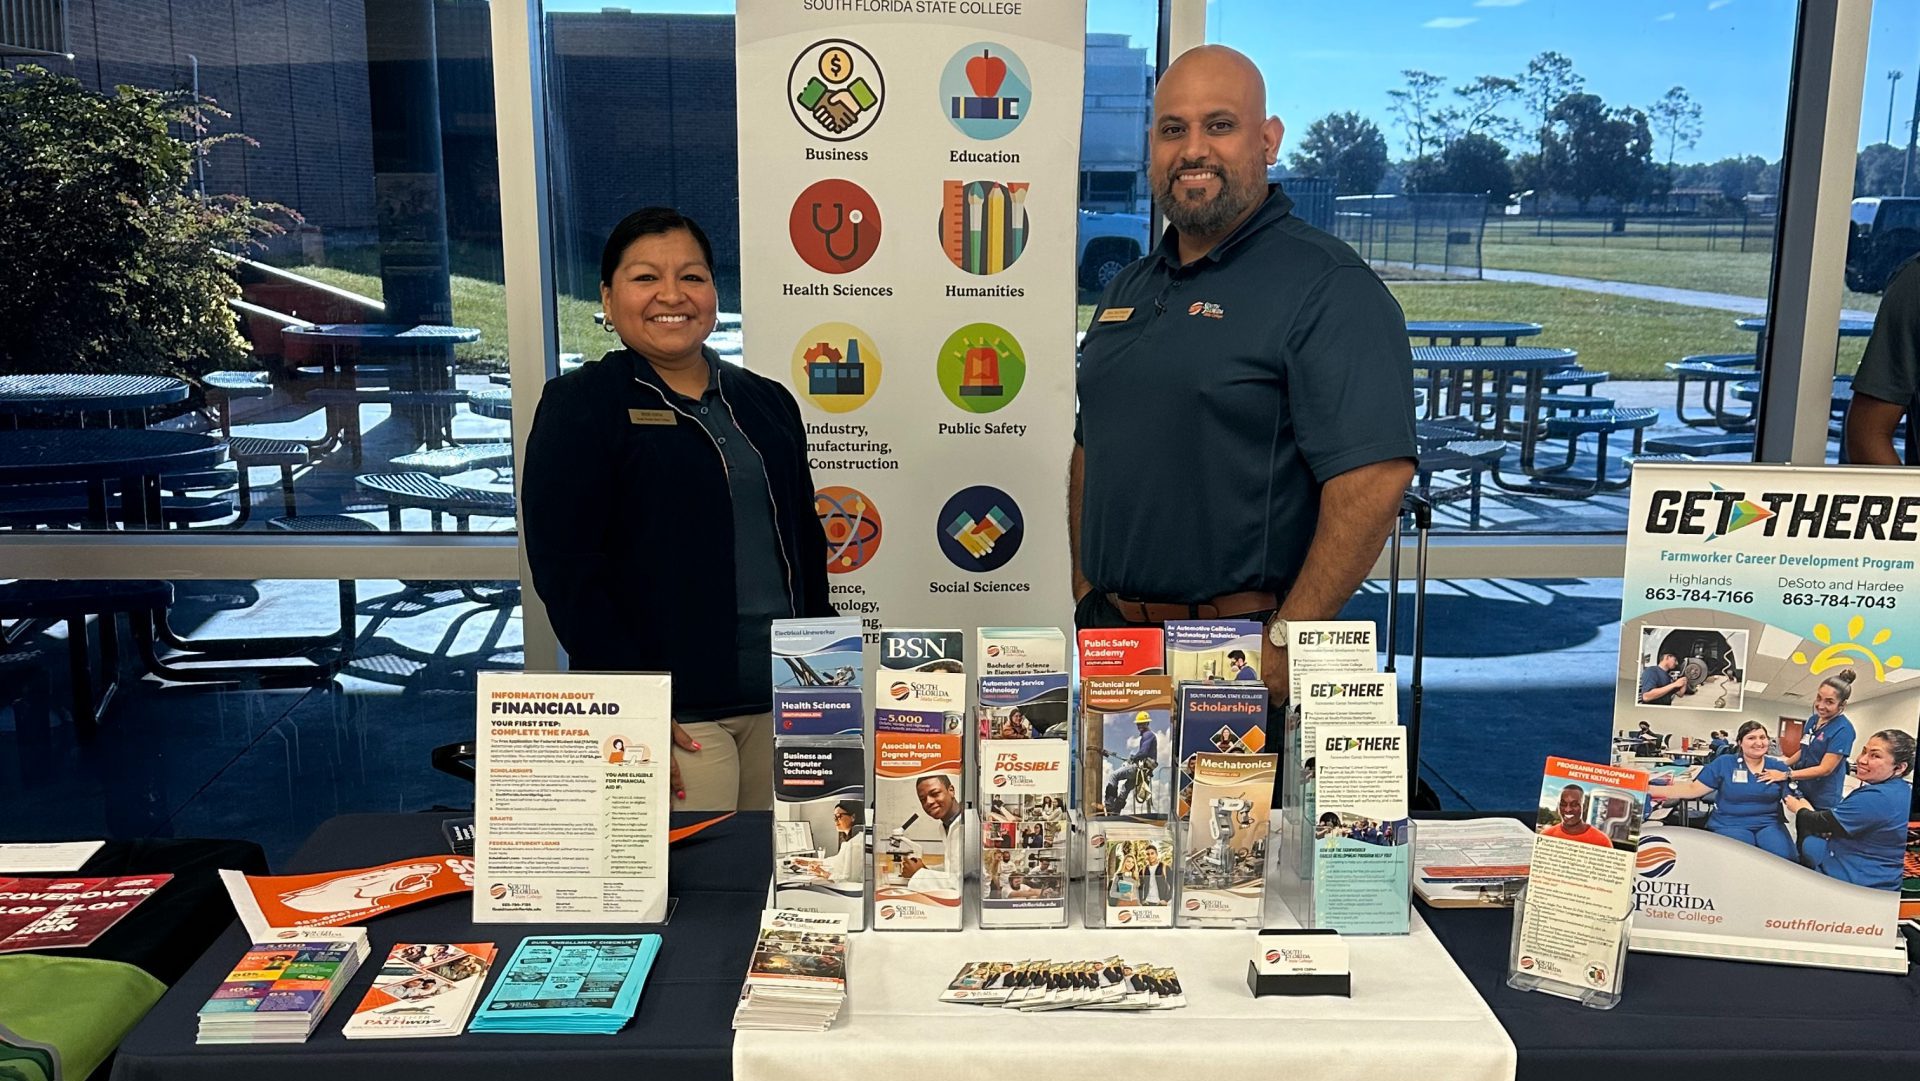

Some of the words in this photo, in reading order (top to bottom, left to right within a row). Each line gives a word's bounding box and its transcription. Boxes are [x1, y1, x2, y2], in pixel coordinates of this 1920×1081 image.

[804, 0, 852, 12] SOUTH
[856, 0, 913, 12] FLORIDA
[916, 1, 956, 14] STATE
[960, 2, 1022, 15] COLLEGE
[805, 148, 868, 162] Business
[950, 150, 1020, 164] Education
[782, 284, 829, 296] Health
[833, 284, 893, 296] Sciences
[946, 285, 1024, 298] Humanities
[806, 423, 868, 437] Industry,
[938, 422, 981, 434] Public
[984, 422, 1028, 436] Safety
[806, 440, 892, 454] nufacturing,
[809, 458, 898, 470] Construction
[1646, 490, 1746, 536] GET
[1761, 492, 1920, 541] THERE
[1661, 550, 1732, 564] Farmworker
[1736, 552, 1776, 565] Career
[1779, 554, 1859, 570] Development
[1862, 556, 1914, 571] Program
[1669, 574, 1732, 587] Highlands
[1778, 577, 1826, 590] DeSoto
[1828, 580, 1853, 591] and
[1857, 580, 1904, 592] Hardee
[827, 583, 866, 596] ience,
[930, 582, 970, 593] Social
[973, 581, 1030, 592] Sciences
[1645, 588, 1754, 604] 863-784-7166
[1782, 593, 1896, 608] 863-784-7043
[829, 599, 880, 614] nology,
[1084, 640, 1111, 648] Public
[1112, 640, 1140, 648] Safety
[1298, 631, 1325, 645] GET
[1329, 631, 1370, 644] THERE
[887, 638, 947, 658] BSN
[1084, 650, 1124, 658] Academy
[911, 682, 938, 692] SOUTH
[982, 686, 1020, 694] Technology
[1090, 680, 1124, 688] Technical
[1125, 680, 1140, 688] and
[560, 692, 595, 700] ABOUT
[915, 690, 949, 698] FLORIDA
[1310, 683, 1337, 698] GET
[1341, 683, 1384, 696] THERE
[491, 702, 586, 715] FINANCIAL
[588, 702, 620, 715] AID
[782, 702, 811, 710] Health
[812, 702, 851, 710] Sciences
[1189, 702, 1262, 714] Scholarships
[491, 728, 541, 736] COMPLETE
[881, 742, 916, 750] Associate
[918, 742, 925, 750] in
[926, 742, 942, 750] Arts
[1326, 737, 1353, 751] GET
[1357, 737, 1401, 751] THERE
[783, 752, 816, 760] Business
[881, 751, 909, 760] Degree
[783, 760, 821, 768] Computer
[994, 762, 1060, 772] POSSIBLE
[1200, 758, 1272, 769] Mechatronics
[783, 767, 833, 776] Technologies
[507, 883, 531, 891] SOUTH
[511, 888, 540, 897] FLORIDA
[80, 888, 156, 899] OVER
[1634, 893, 1715, 911] FLORIDA
[774, 916, 842, 925] POSSIBLE
[1646, 908, 1675, 920] State
[1677, 910, 1723, 924] College
[1765, 918, 1884, 936] southflorida.edu
